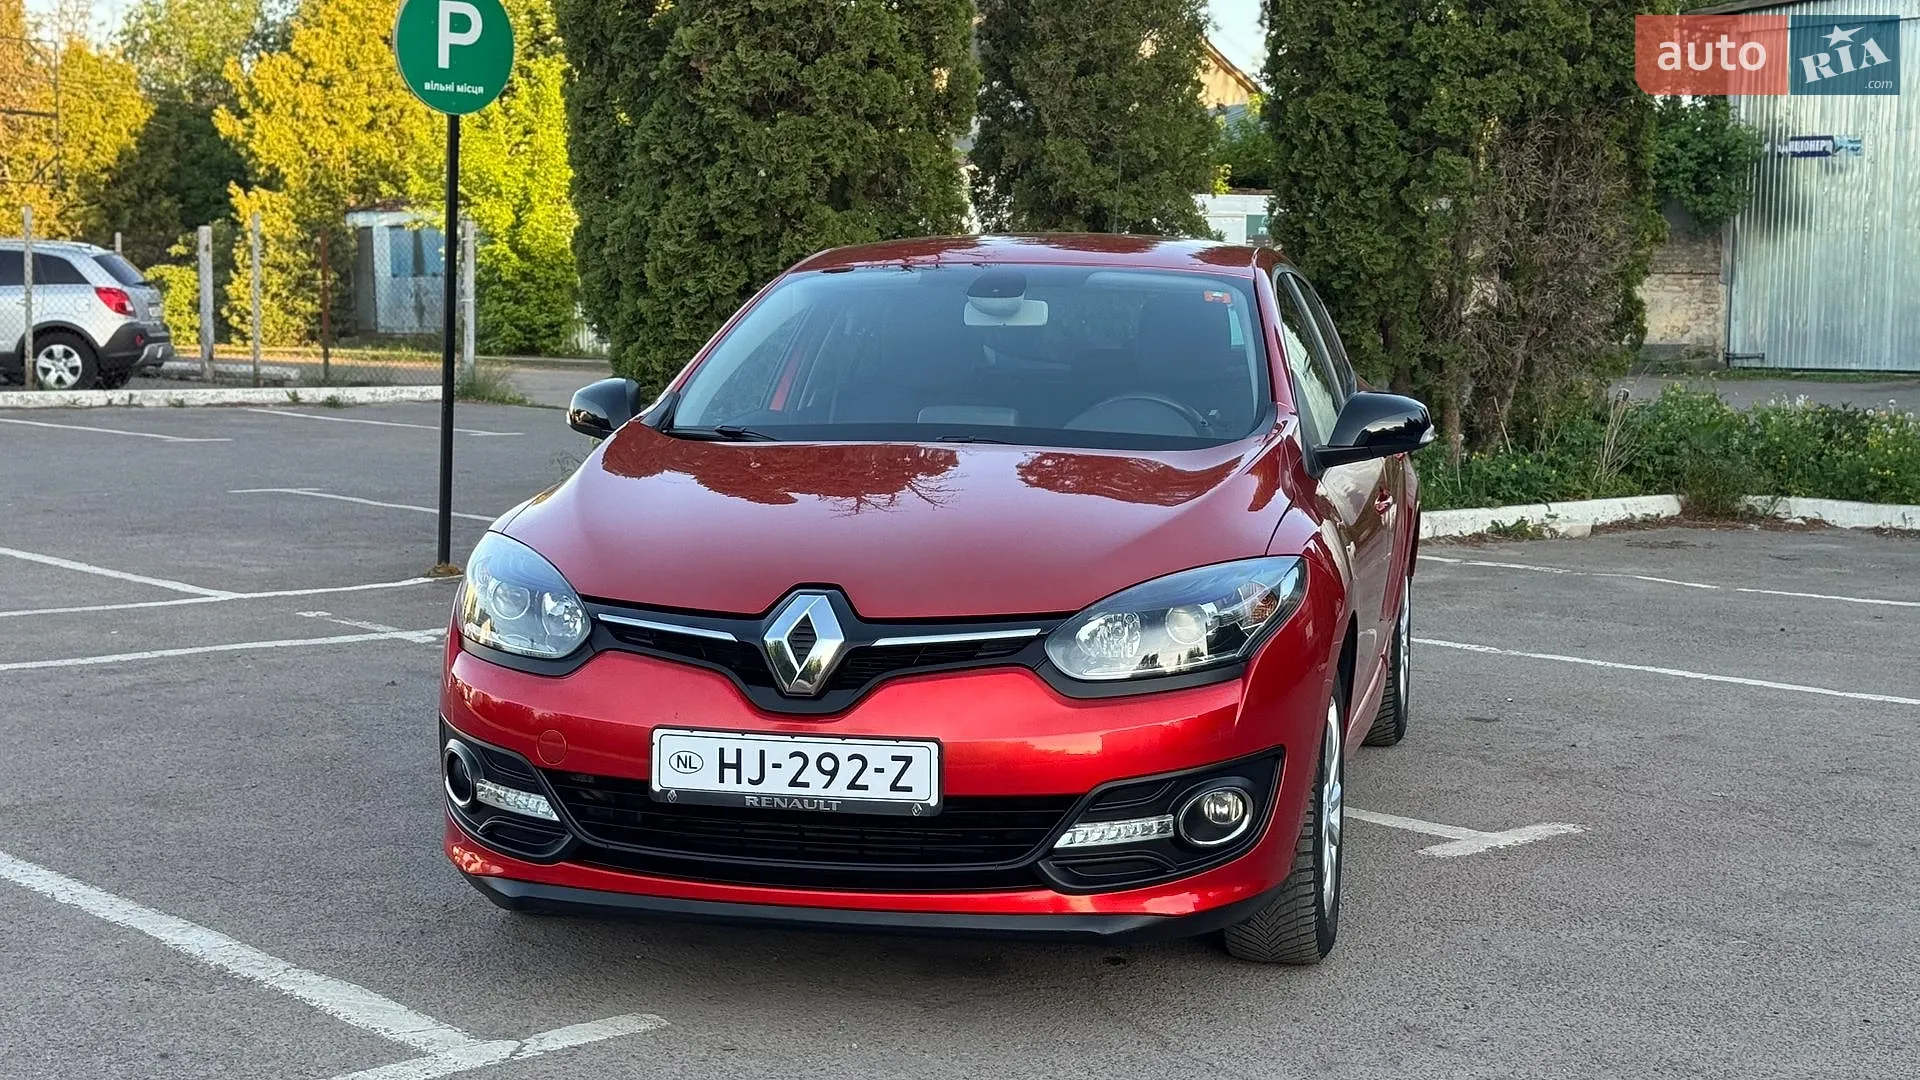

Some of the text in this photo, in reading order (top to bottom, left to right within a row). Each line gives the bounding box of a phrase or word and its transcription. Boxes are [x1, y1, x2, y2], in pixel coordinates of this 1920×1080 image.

[438, 0, 483, 69] P
[424, 80, 484, 95] вільні місця
[676, 747, 913, 793] NL HJ-292-Z
[745, 795, 842, 811] RENAULT
